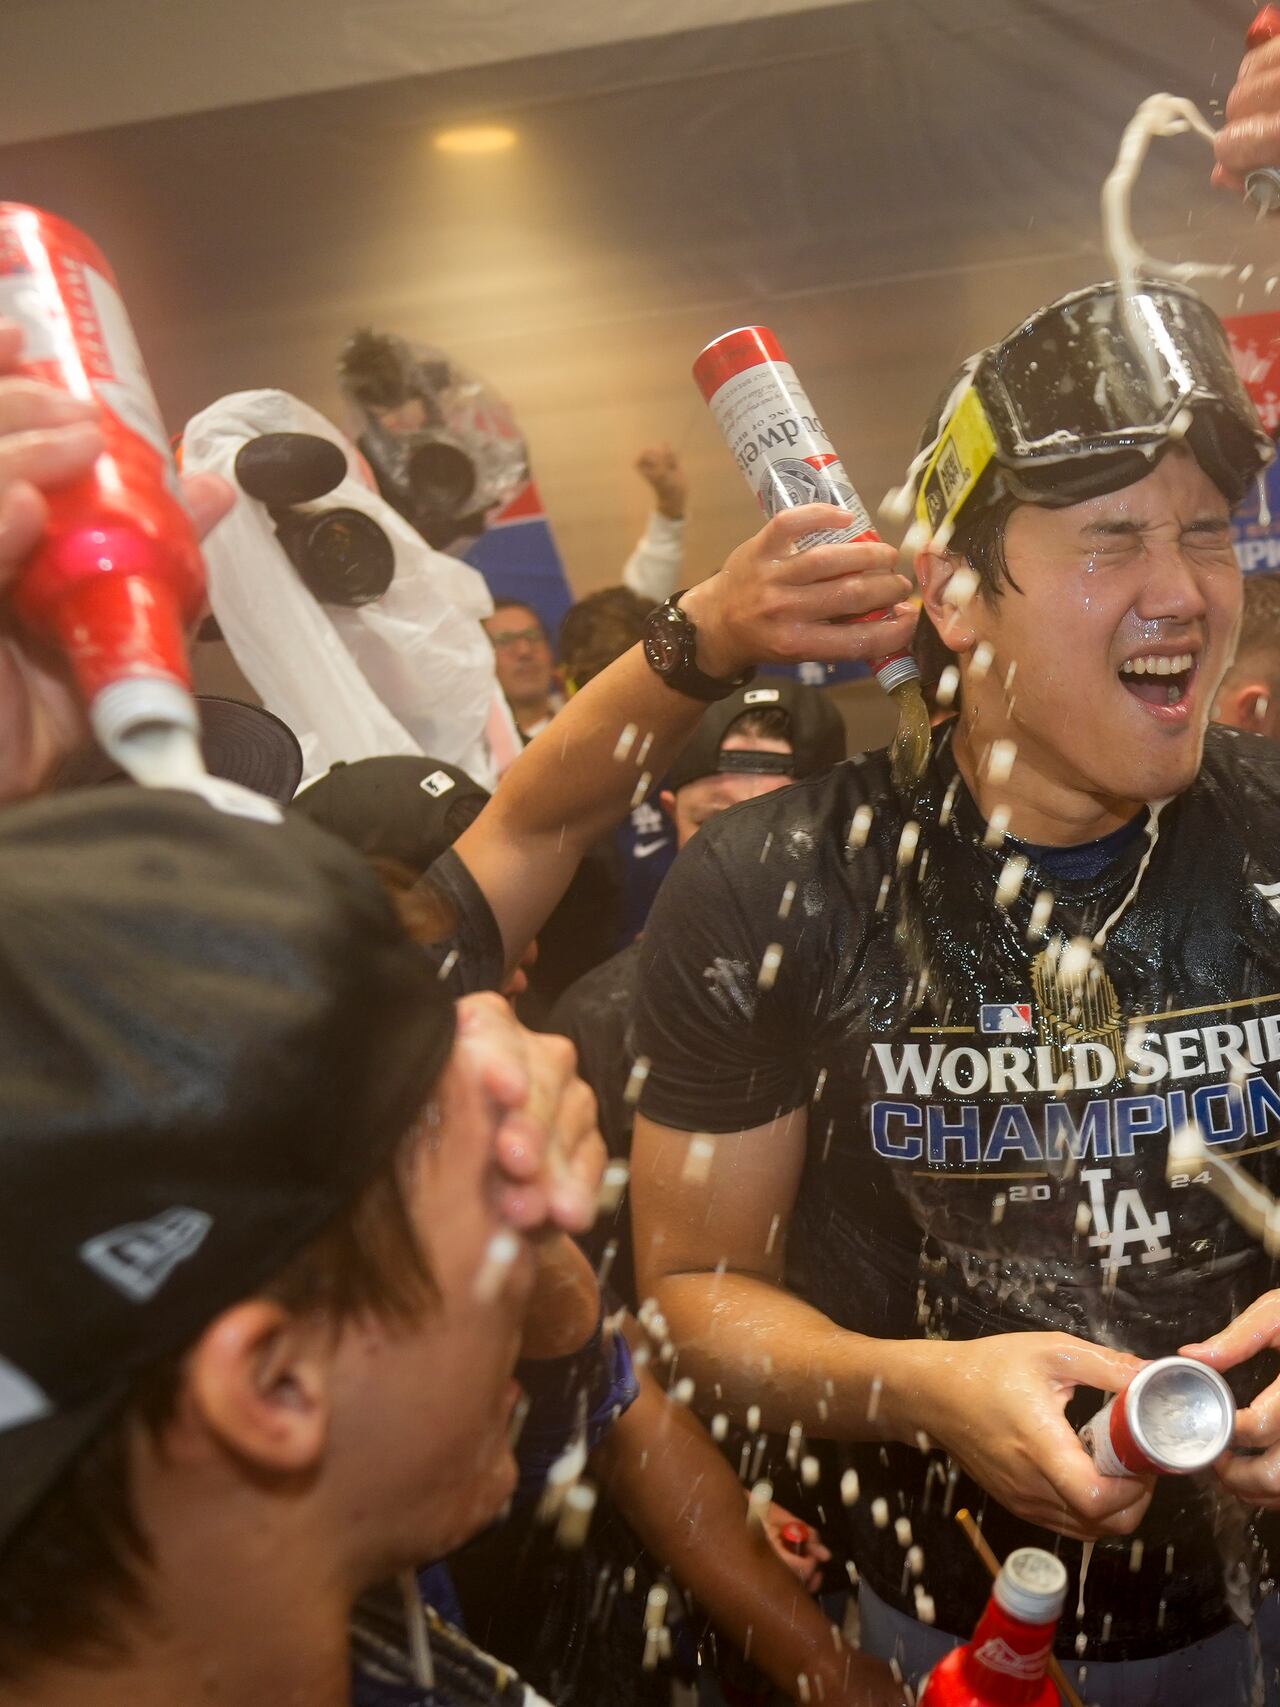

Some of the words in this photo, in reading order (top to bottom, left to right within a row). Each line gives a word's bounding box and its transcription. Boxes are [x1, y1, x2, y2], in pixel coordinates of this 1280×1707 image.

[871, 1042, 1116, 1096] WORLD
[1008, 1184, 1051, 1202] 20
[1170, 1171, 1213, 1188] 24
[1080, 1168, 1173, 1267] LA
